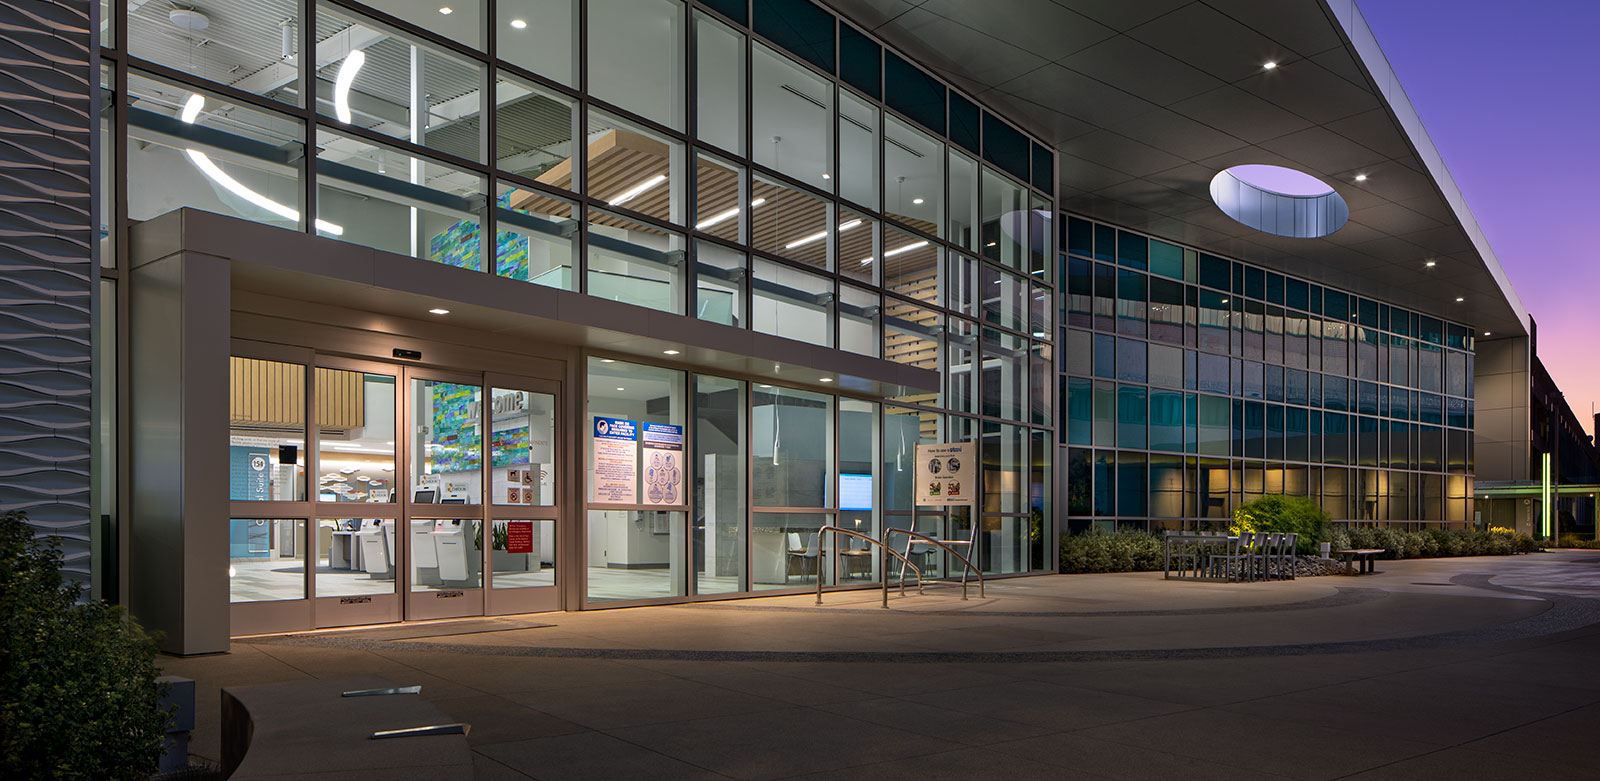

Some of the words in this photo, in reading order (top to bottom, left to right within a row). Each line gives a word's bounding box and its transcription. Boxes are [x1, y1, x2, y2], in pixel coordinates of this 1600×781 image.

[467, 391, 523, 420] wome
[253, 460, 264, 468] 154
[256, 472, 264, 493] Suite
